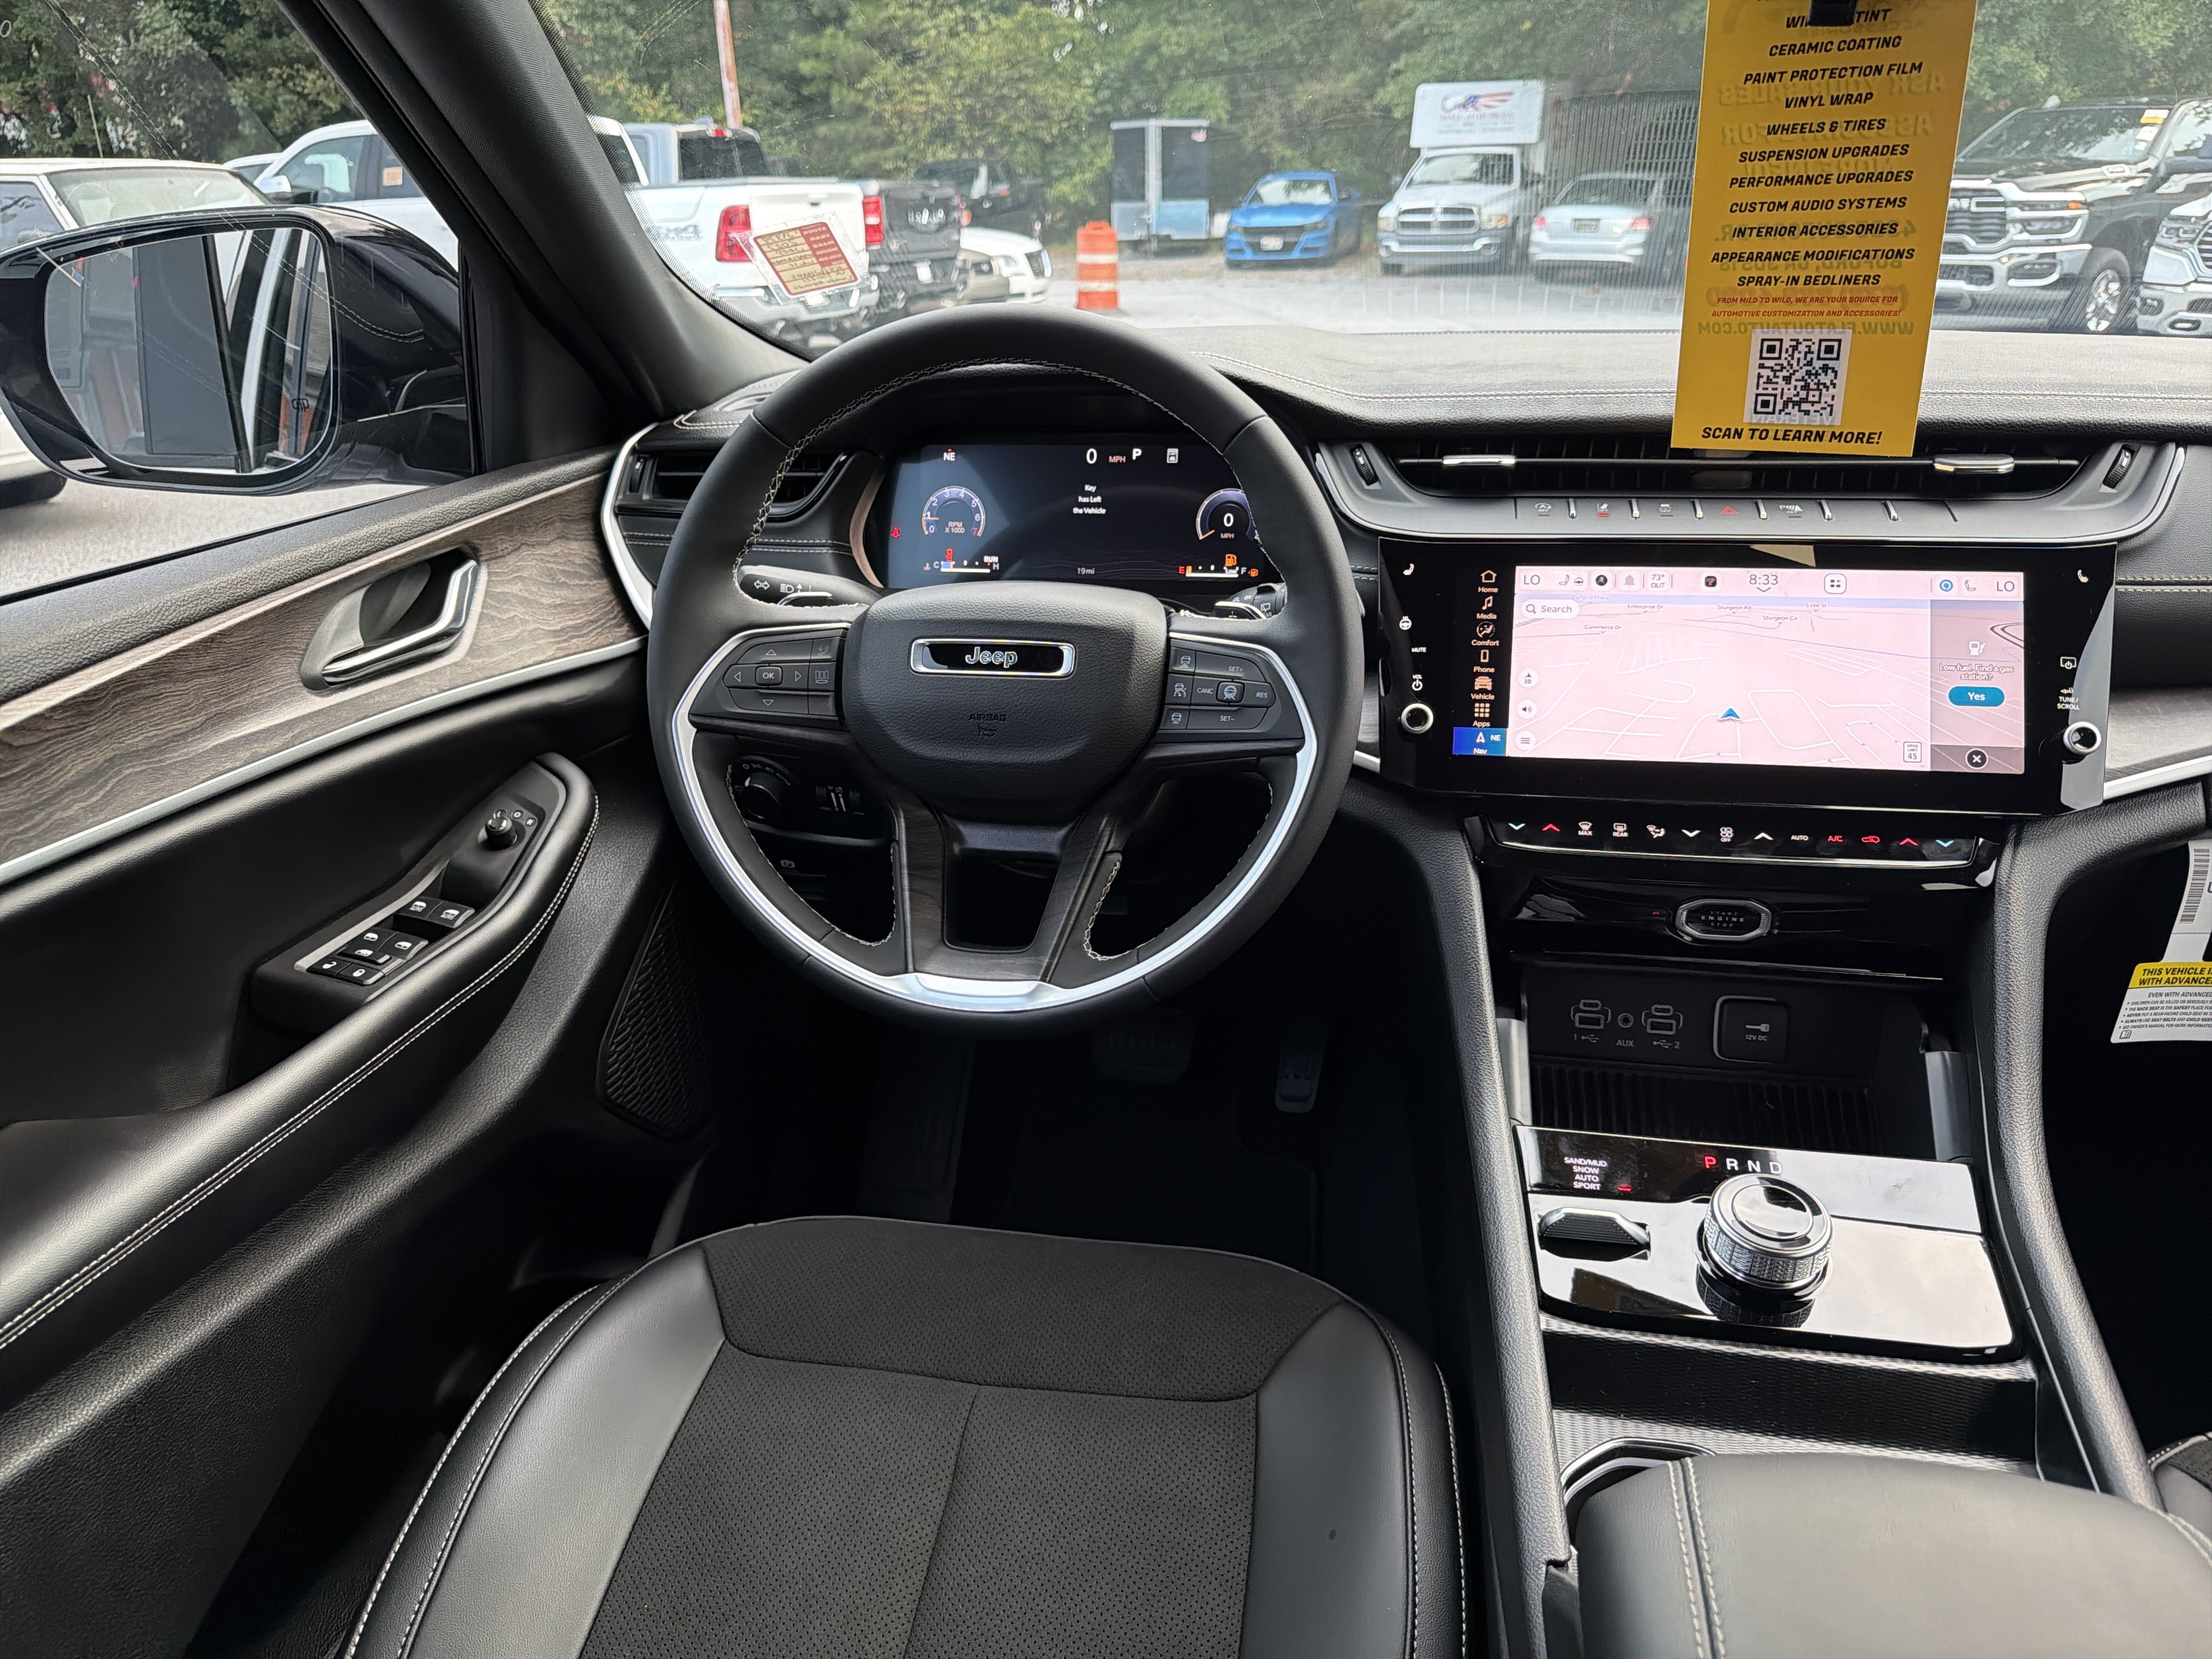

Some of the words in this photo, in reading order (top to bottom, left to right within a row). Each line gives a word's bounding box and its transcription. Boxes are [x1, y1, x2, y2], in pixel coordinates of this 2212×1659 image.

[1855, 8, 1893, 23] TINT
[1769, 41, 1833, 56] CERAMIC
[1837, 36, 1901, 52] COATING
[1744, 71, 1787, 84] PAINT
[1790, 65, 1883, 81] PROTECTION
[1887, 62, 1922, 75] FILM
[1786, 95, 1824, 108] VINYL
[1830, 92, 1873, 105] WRAP
[1767, 122, 1825, 135] WHEELS
[1829, 121, 1838, 132] &
[1844, 119, 1886, 131] TIRES
[1739, 148, 1828, 162] SUSPENSION
[1832, 144, 1909, 158] UPGRADES
[1730, 174, 1833, 188] PERFORMANCE
[1837, 171, 1913, 184] UPGRADES
[1730, 201, 1788, 213] CUSTOM
[1791, 200, 1834, 211] AUDIO
[1838, 197, 1907, 210] SYSTEMS
[1733, 226, 1797, 238] INTERIOR
[1799, 223, 1898, 236] ACCESSORIES
[1712, 251, 1800, 262] APPEARANCE
[1803, 249, 1915, 261] MODIFICATIONS
[1738, 276, 1799, 286] SPRAY-IN
[1803, 275, 1881, 285] BEDLINERS
[1702, 427, 1743, 439] SCAN
[1749, 428, 1769, 440] TO
[1773, 430, 1825, 442] LEARN
[1829, 431, 1882, 444] MORE!
[943, 453, 955, 461] NE
[1086, 448, 1097, 464] 0
[1132, 448, 1142, 460] P
[1085, 484, 1097, 493] Key
[1223, 513, 1234, 527] 0
[1241, 567, 1247, 575] F
[1523, 574, 1541, 585] LO
[1749, 574, 1779, 585] 8:33
[1996, 580, 2015, 592] LO
[1541, 605, 1572, 613] Search
[965, 646, 1018, 668] Jeep
[1960, 673, 1993, 681] station?
[1968, 692, 1985, 701] Yes
[969, 713, 1007, 721] AIRBAG
[2142, 968, 2163, 976] THIS
[2165, 967, 2207, 975] VEHICLE
[2139, 977, 2162, 986] WITH
[2164, 977, 2212, 985] ADVANCE
[1564, 1156, 1607, 1167] SAND/MUD
[1704, 1155, 1717, 1169] P
[1726, 1158, 1739, 1171] R
[1748, 1160, 1760, 1173] N
[1769, 1161, 1782, 1173] D
[1573, 1166, 1599, 1174] SNOW
[1573, 1182, 1601, 1190] SPORT
